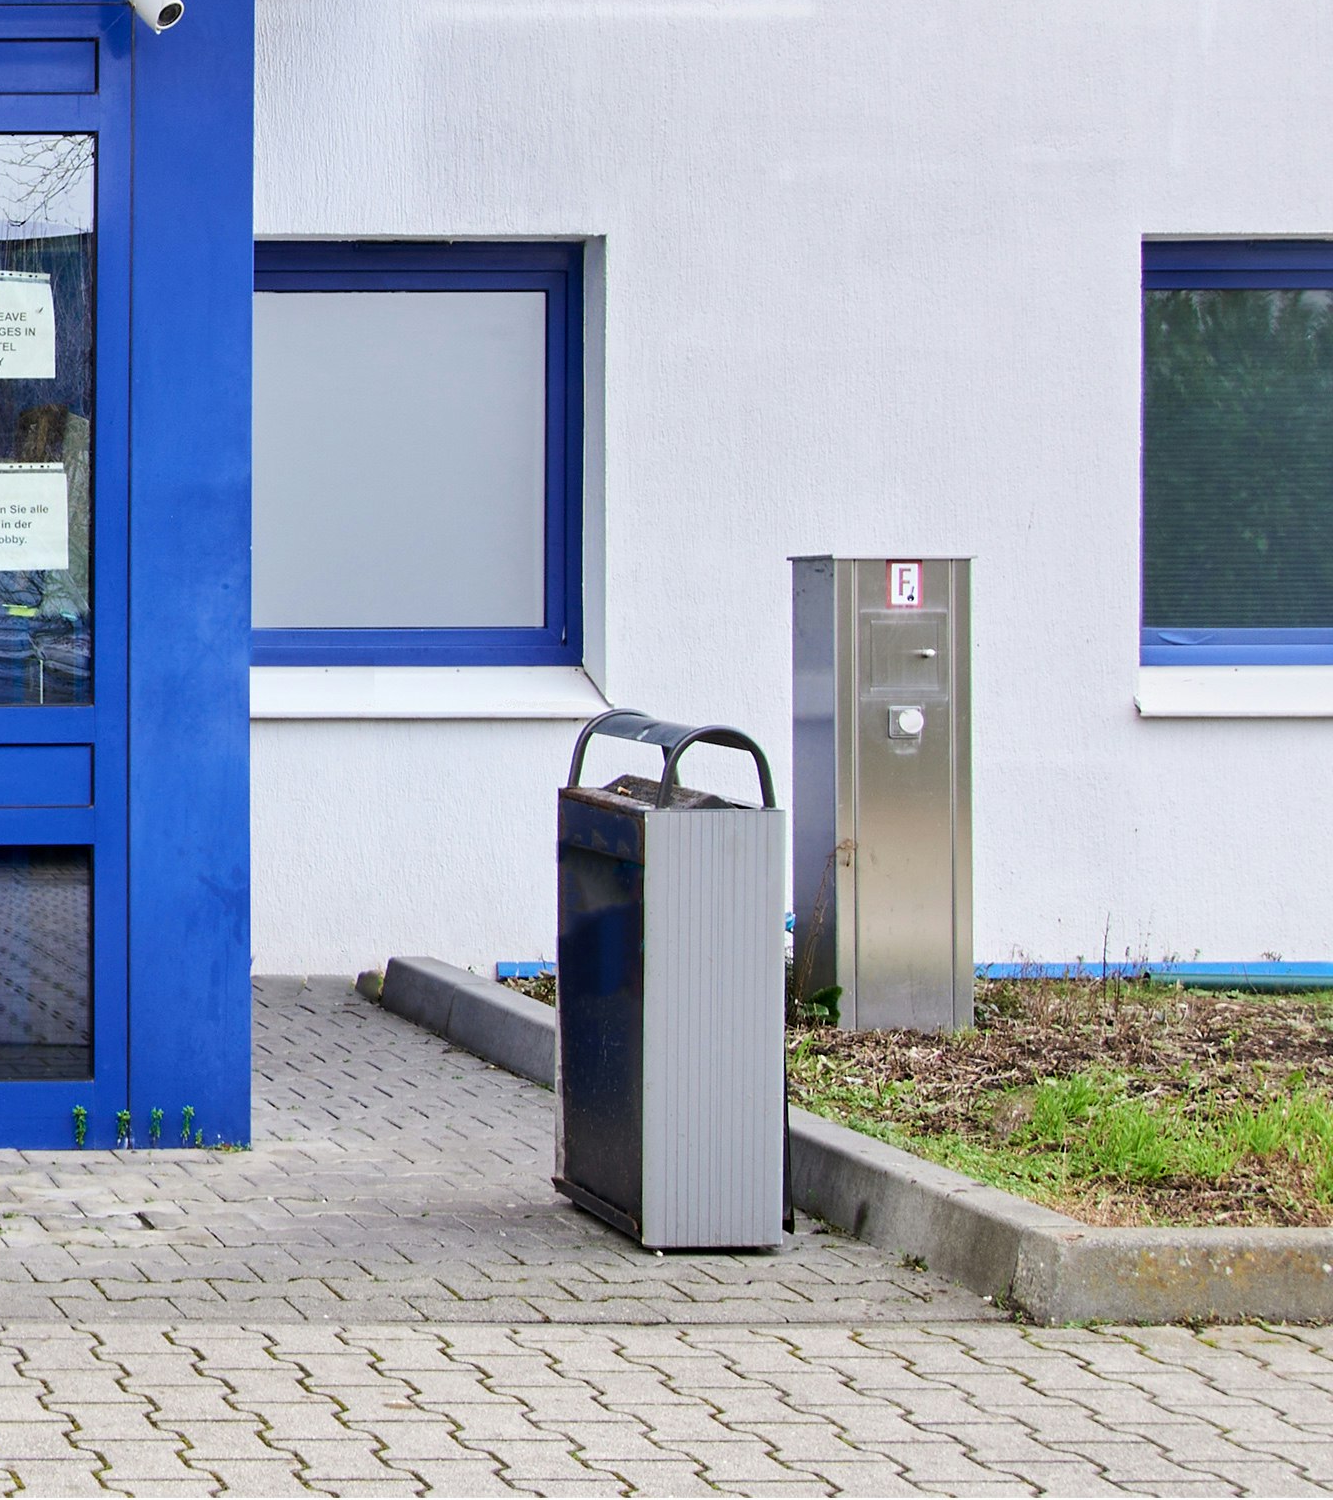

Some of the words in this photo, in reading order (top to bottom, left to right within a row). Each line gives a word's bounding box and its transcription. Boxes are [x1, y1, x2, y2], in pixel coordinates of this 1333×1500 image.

[24, 327, 36, 337] IN
[9, 504, 27, 514] Sie
[29, 504, 49, 514] alle
[1, 520, 11, 529] in
[14, 520, 32, 529] der
[898, 567, 911, 596] F
